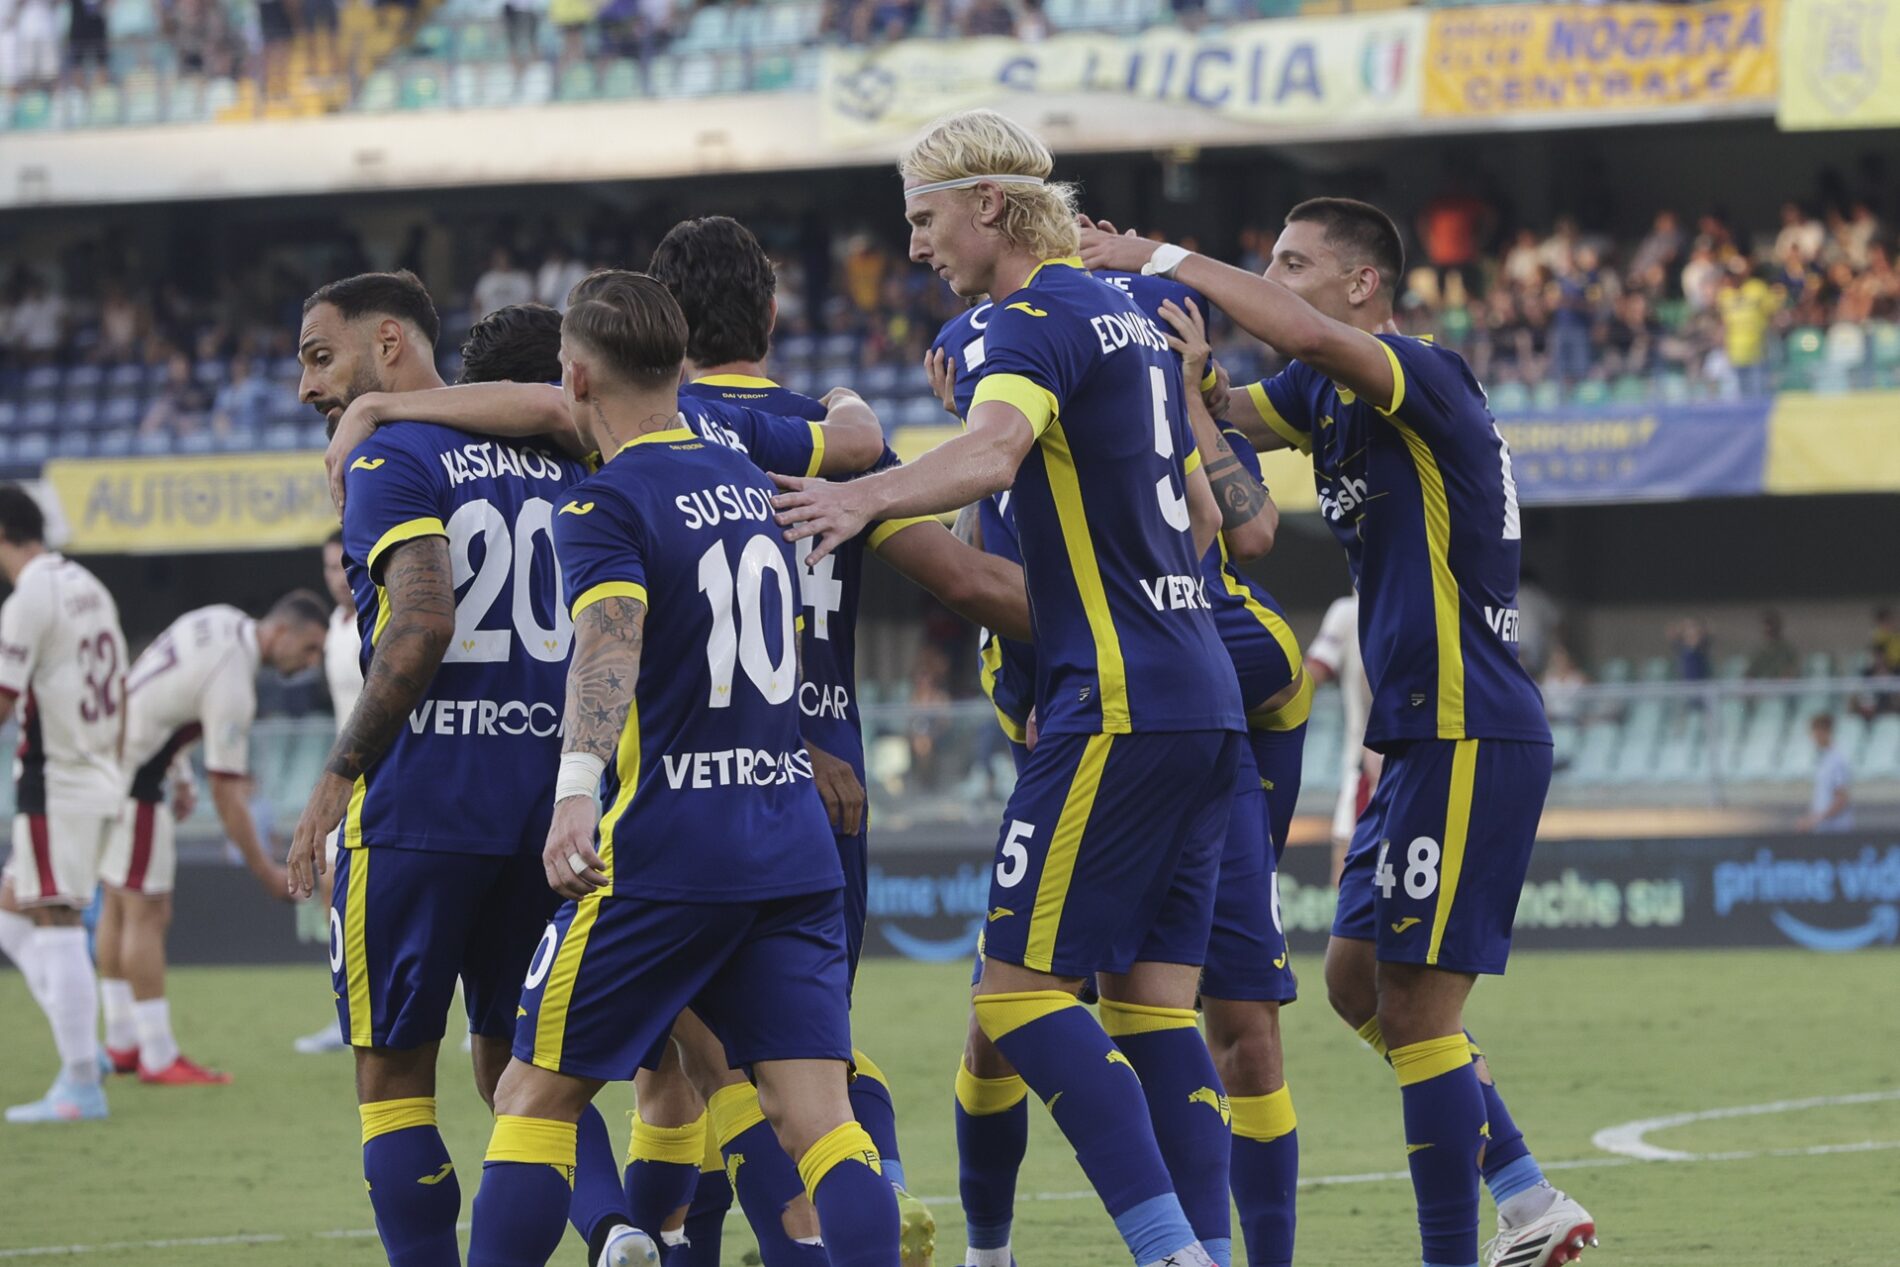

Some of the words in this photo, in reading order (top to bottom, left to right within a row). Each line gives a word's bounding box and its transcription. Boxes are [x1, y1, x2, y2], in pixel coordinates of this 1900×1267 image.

[1547, 8, 1766, 62] NOGARA
[1463, 66, 1734, 108] CENTRALE
[441, 497, 575, 662] 20
[698, 534, 798, 706] 10
[78, 631, 119, 723] 32
[408, 700, 566, 738] VETROC
[996, 819, 1036, 888] 5
[1375, 836, 1440, 900] 48
[1712, 847, 1836, 916] prime
